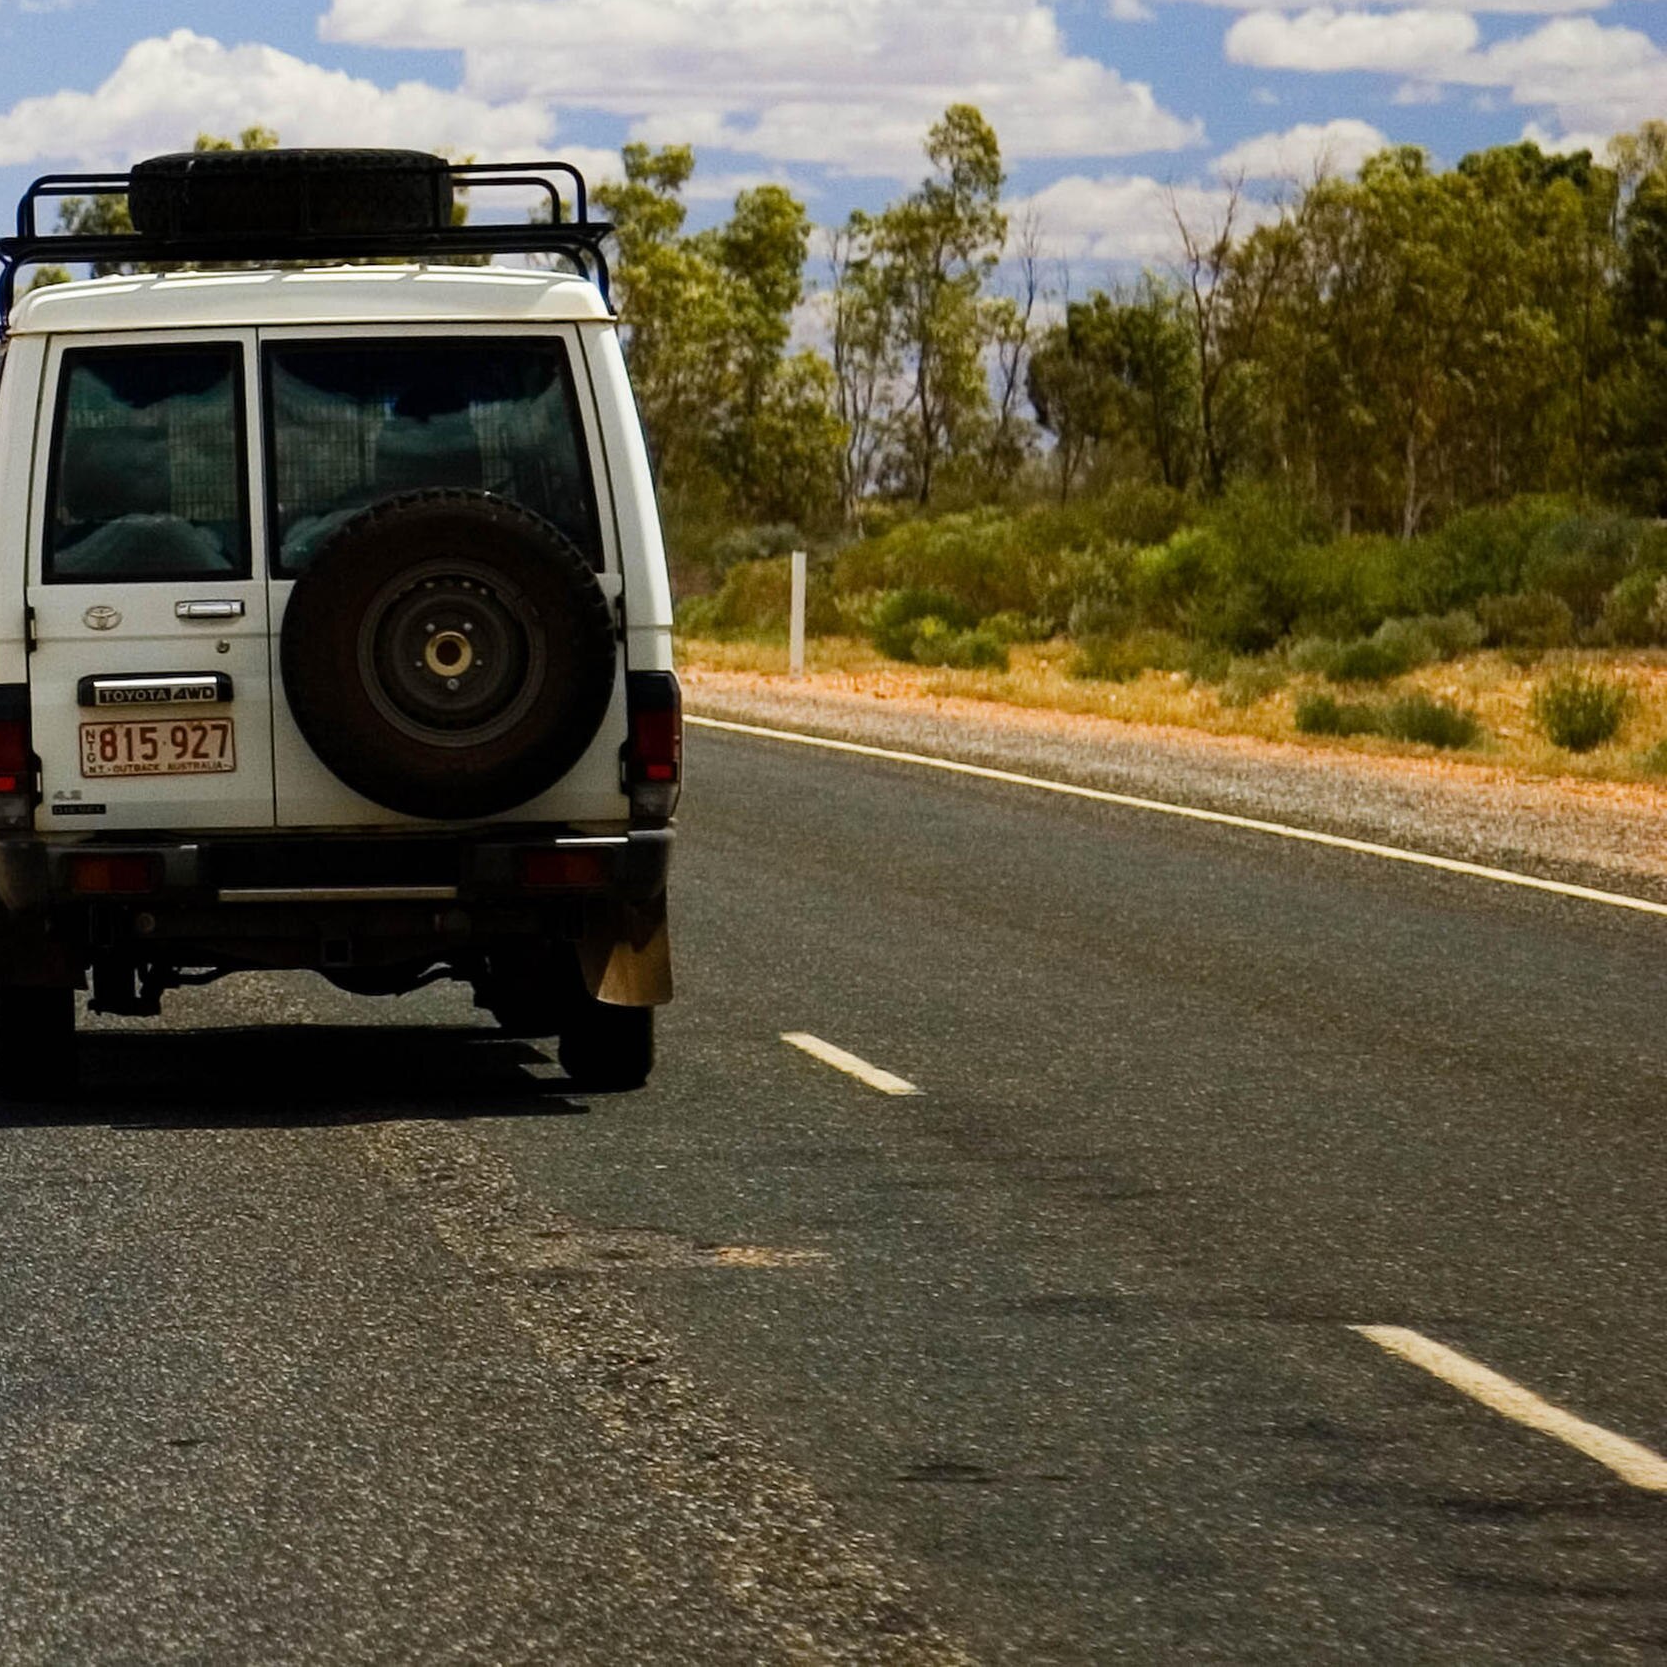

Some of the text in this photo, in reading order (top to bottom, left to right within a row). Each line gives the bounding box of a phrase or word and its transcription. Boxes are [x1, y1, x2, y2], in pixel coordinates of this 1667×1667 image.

[103, 686, 215, 703] TOYOTA 4WD
[113, 763, 160, 773] OUTBACK
[167, 760, 223, 771] AUSTRALIA
